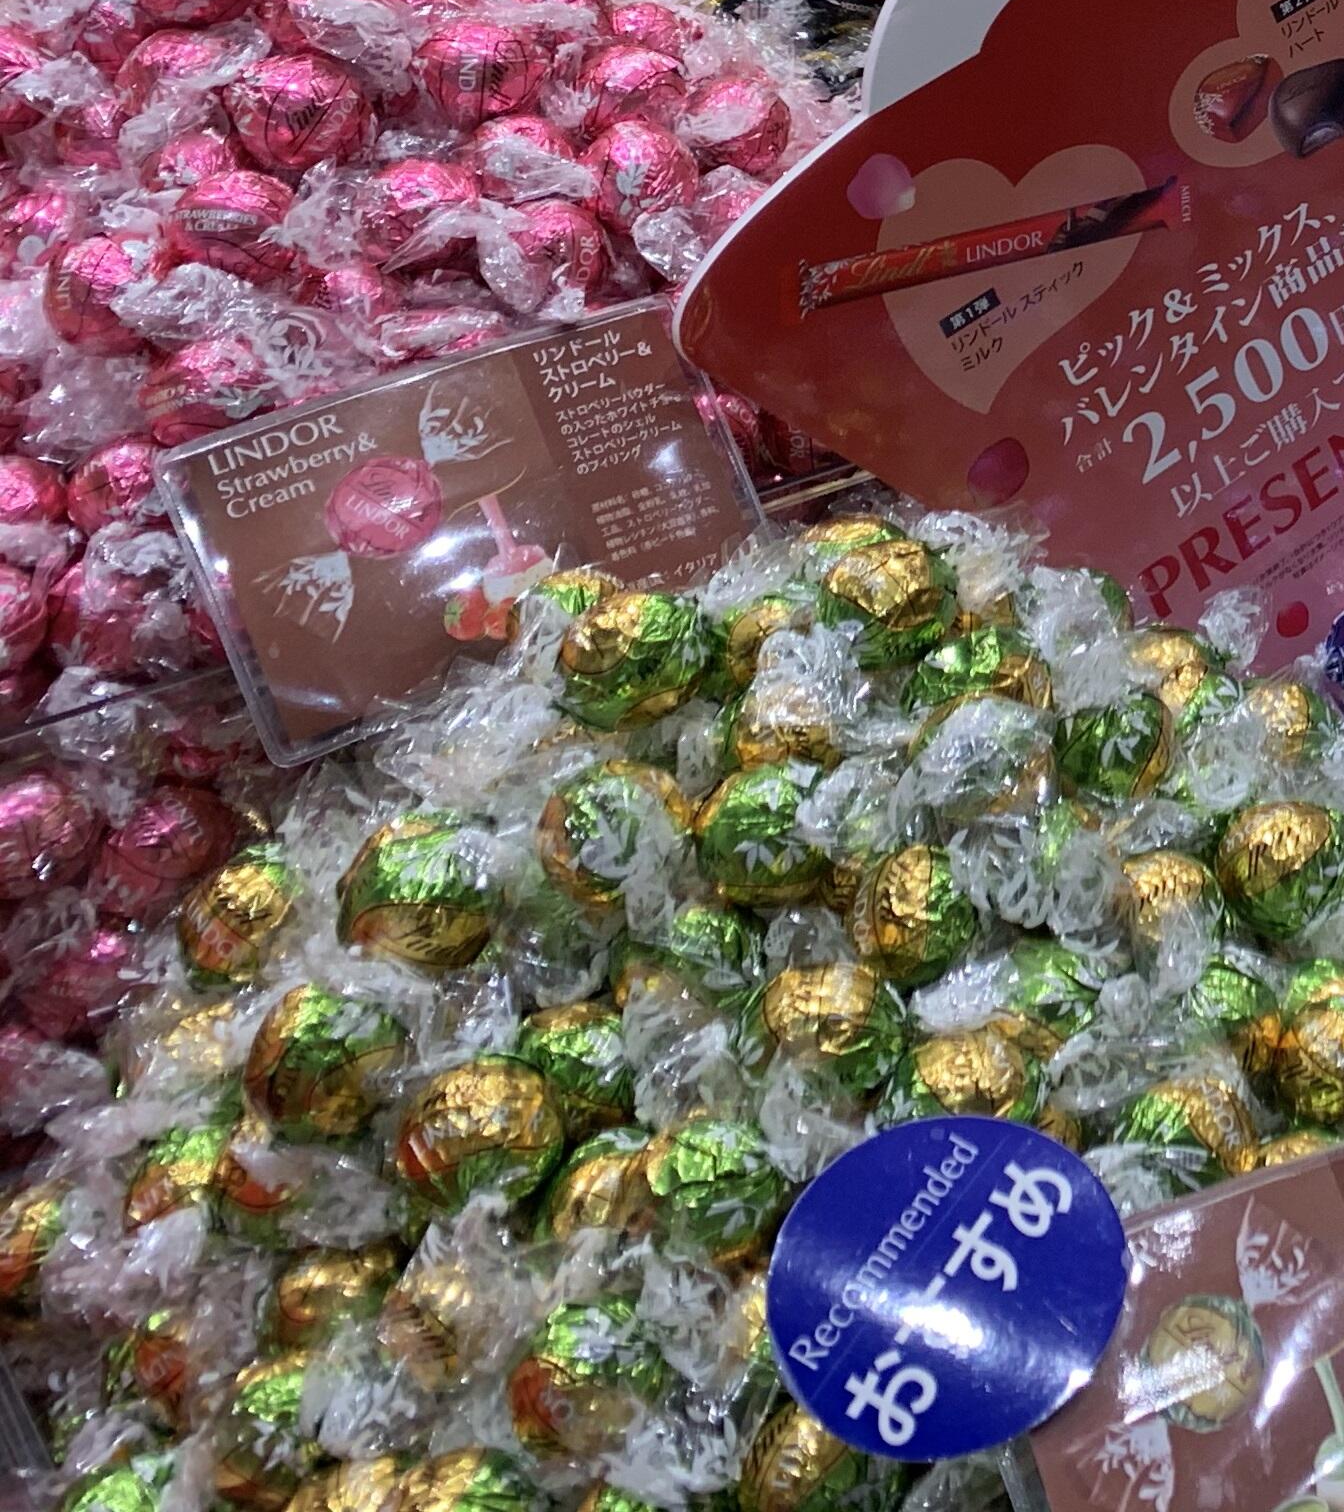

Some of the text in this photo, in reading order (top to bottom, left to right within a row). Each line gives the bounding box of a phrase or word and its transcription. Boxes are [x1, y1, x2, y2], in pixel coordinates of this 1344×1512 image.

[1288, 27, 1326, 59] ハート
[844, 230, 1045, 291] Lindt LINDOR
[948, 296, 991, 331] 第1弾
[950, 260, 1086, 355] リンドール スティック
[532, 329, 622, 367] リンドール
[539, 341, 653, 386] ストロベリー&
[959, 337, 1005, 373] ミルク
[548, 372, 617, 404] クリーム
[555, 382, 666, 424] ストロベリーパウダー
[207, 414, 344, 477] LINDOR
[566, 413, 656, 450] コレートのシェル
[571, 420, 683, 463] ストロベリークリーム
[576, 444, 642, 476] のフィリング
[1075, 438, 1113, 474] 合計
[225, 478, 317, 520] Cream
[345, 494, 411, 540] LINDOR
[788, 1131, 980, 1372] Recommended
[844, 1160, 1073, 1447] おすすめ
